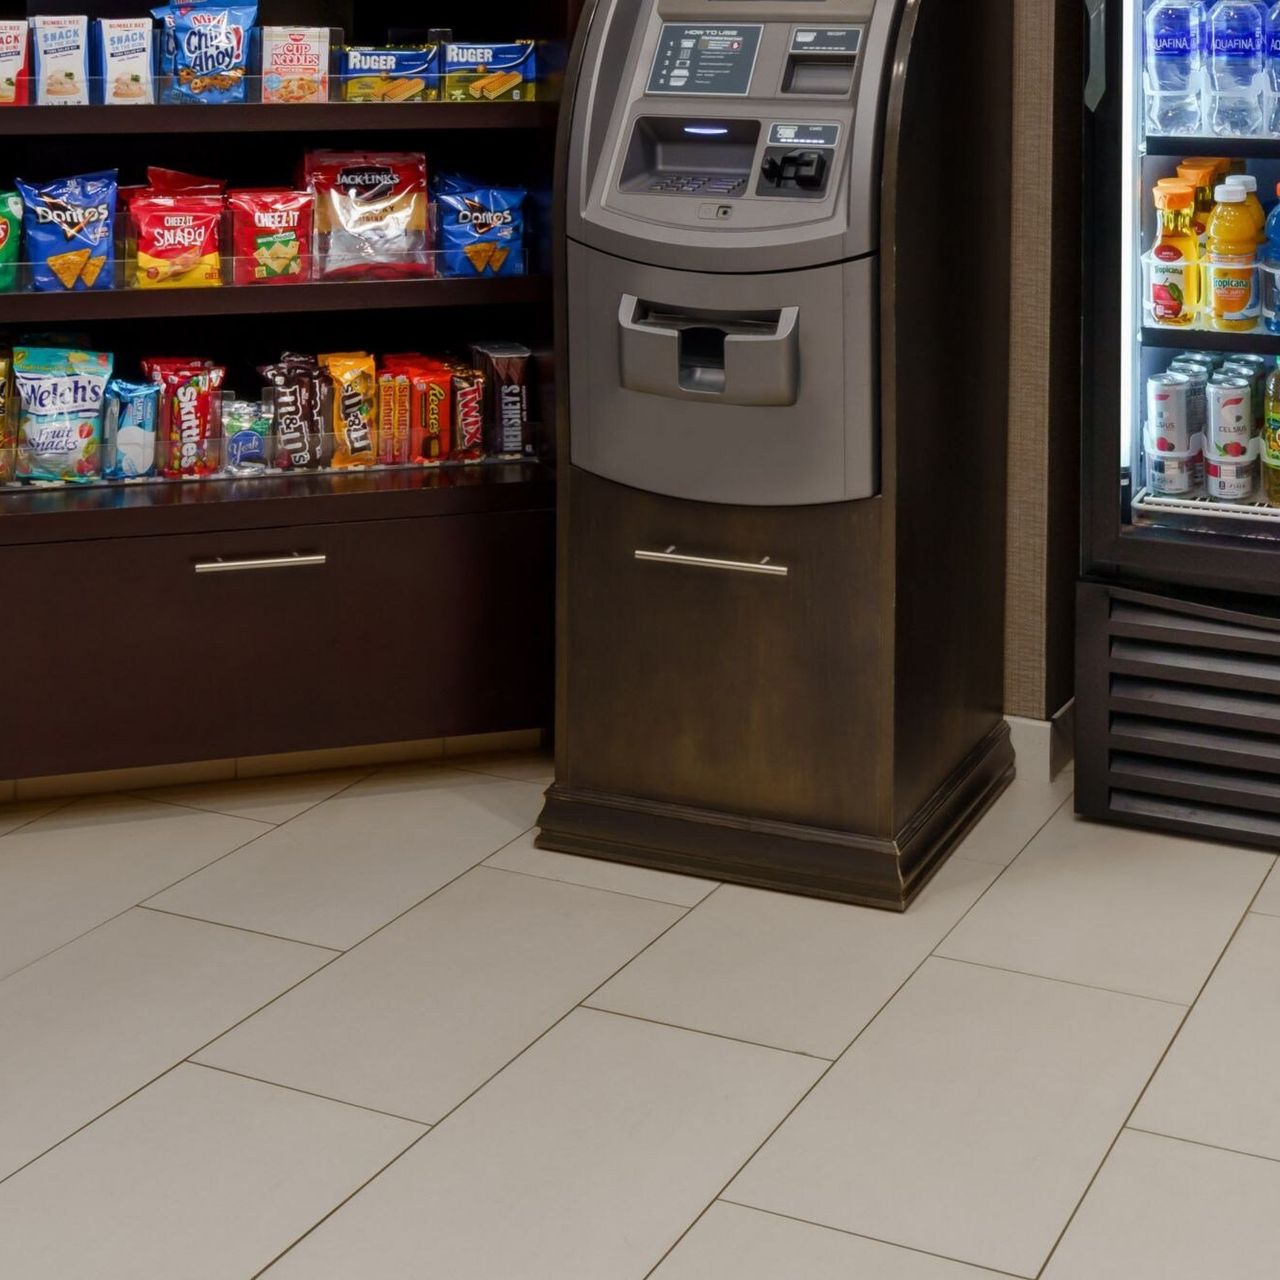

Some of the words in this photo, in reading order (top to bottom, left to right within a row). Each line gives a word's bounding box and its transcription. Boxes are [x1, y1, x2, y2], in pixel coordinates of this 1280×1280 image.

[43, 28, 80, 42] SNACK
[110, 31, 145, 46] SNACK
[283, 43, 311, 54] CUP
[1211, 38, 1254, 51] AQUAFINA
[272, 53, 320, 66] NOODLES
[348, 51, 396, 69] RUGER
[446, 44, 493, 63] RUGER
[37, 204, 108, 224] Doritos
[458, 210, 512, 225] Doritos
[1155, 266, 1183, 275] Tropicana
[1214, 277, 1249, 289] Tropicana
[20, 380, 102, 408] Welch's
[457, 379, 484, 447] TWIX
[177, 386, 201, 468] Skittles
